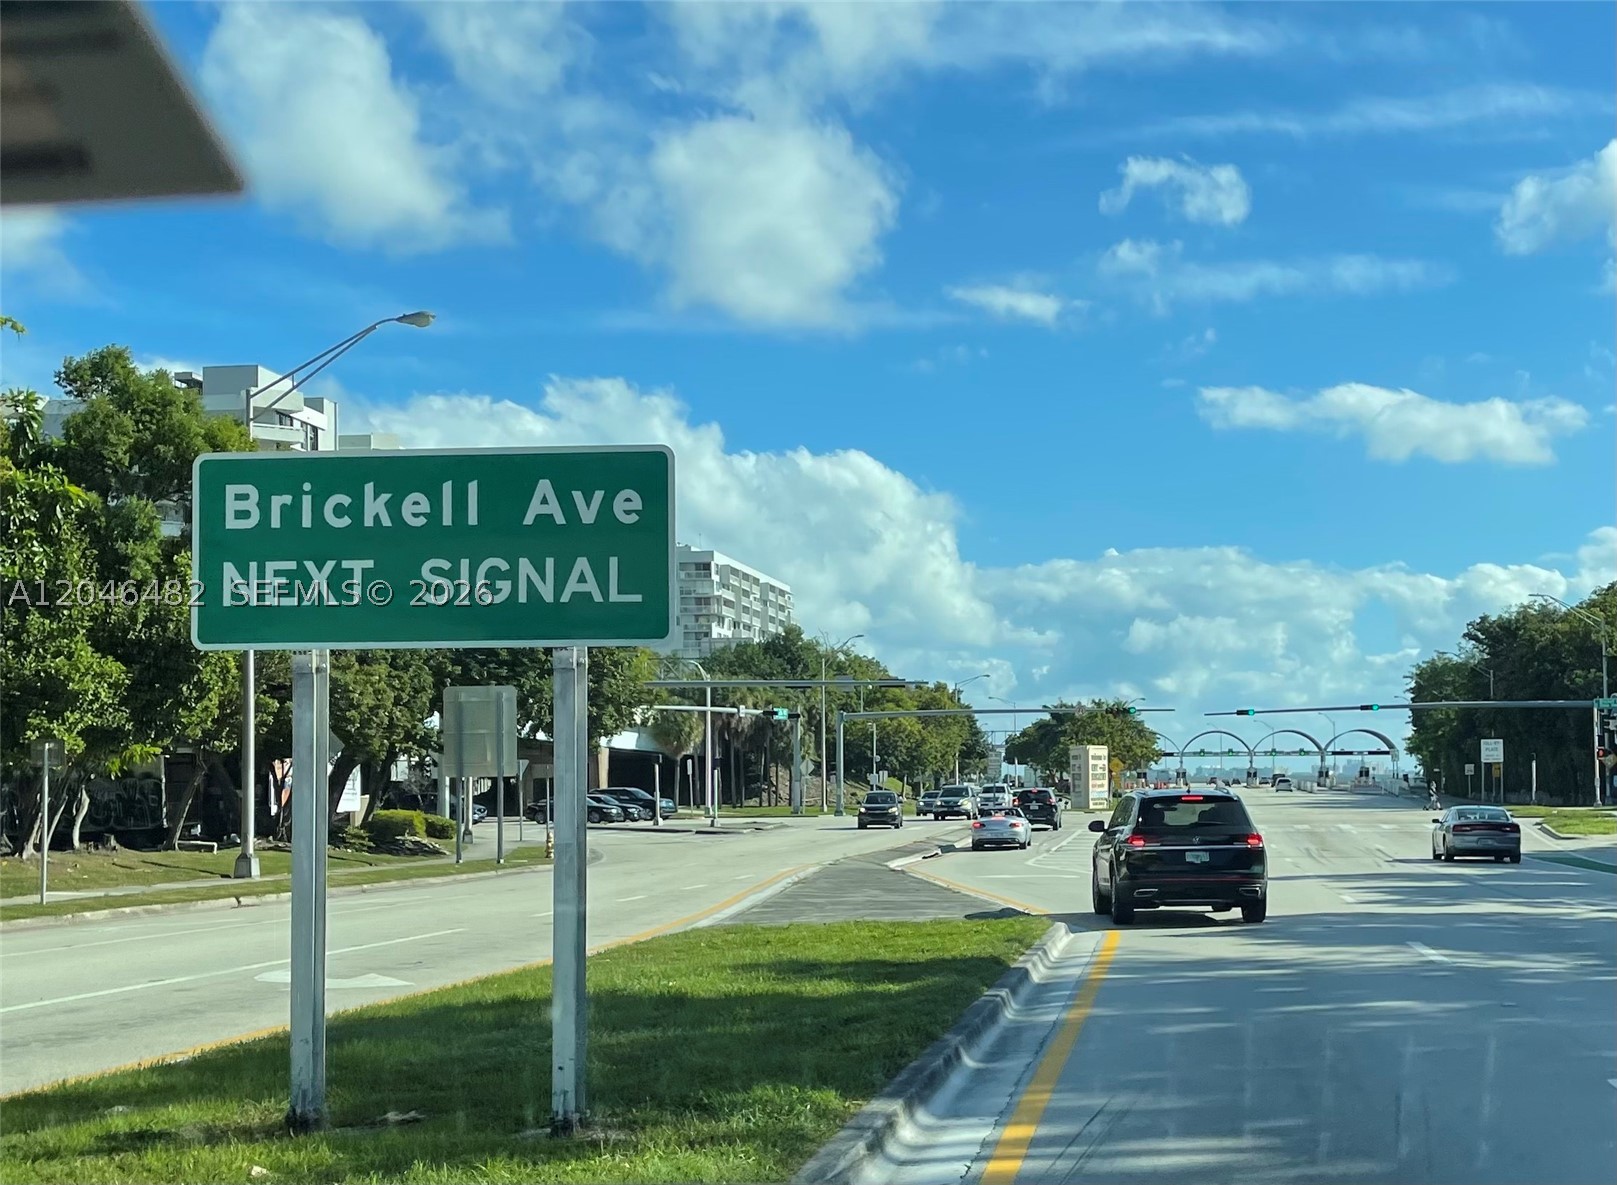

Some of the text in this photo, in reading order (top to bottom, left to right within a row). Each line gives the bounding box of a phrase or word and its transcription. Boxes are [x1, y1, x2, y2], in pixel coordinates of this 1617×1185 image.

[225, 479, 644, 530] Brickell Ave
[222, 556, 643, 607] NEXT SIGNAL
